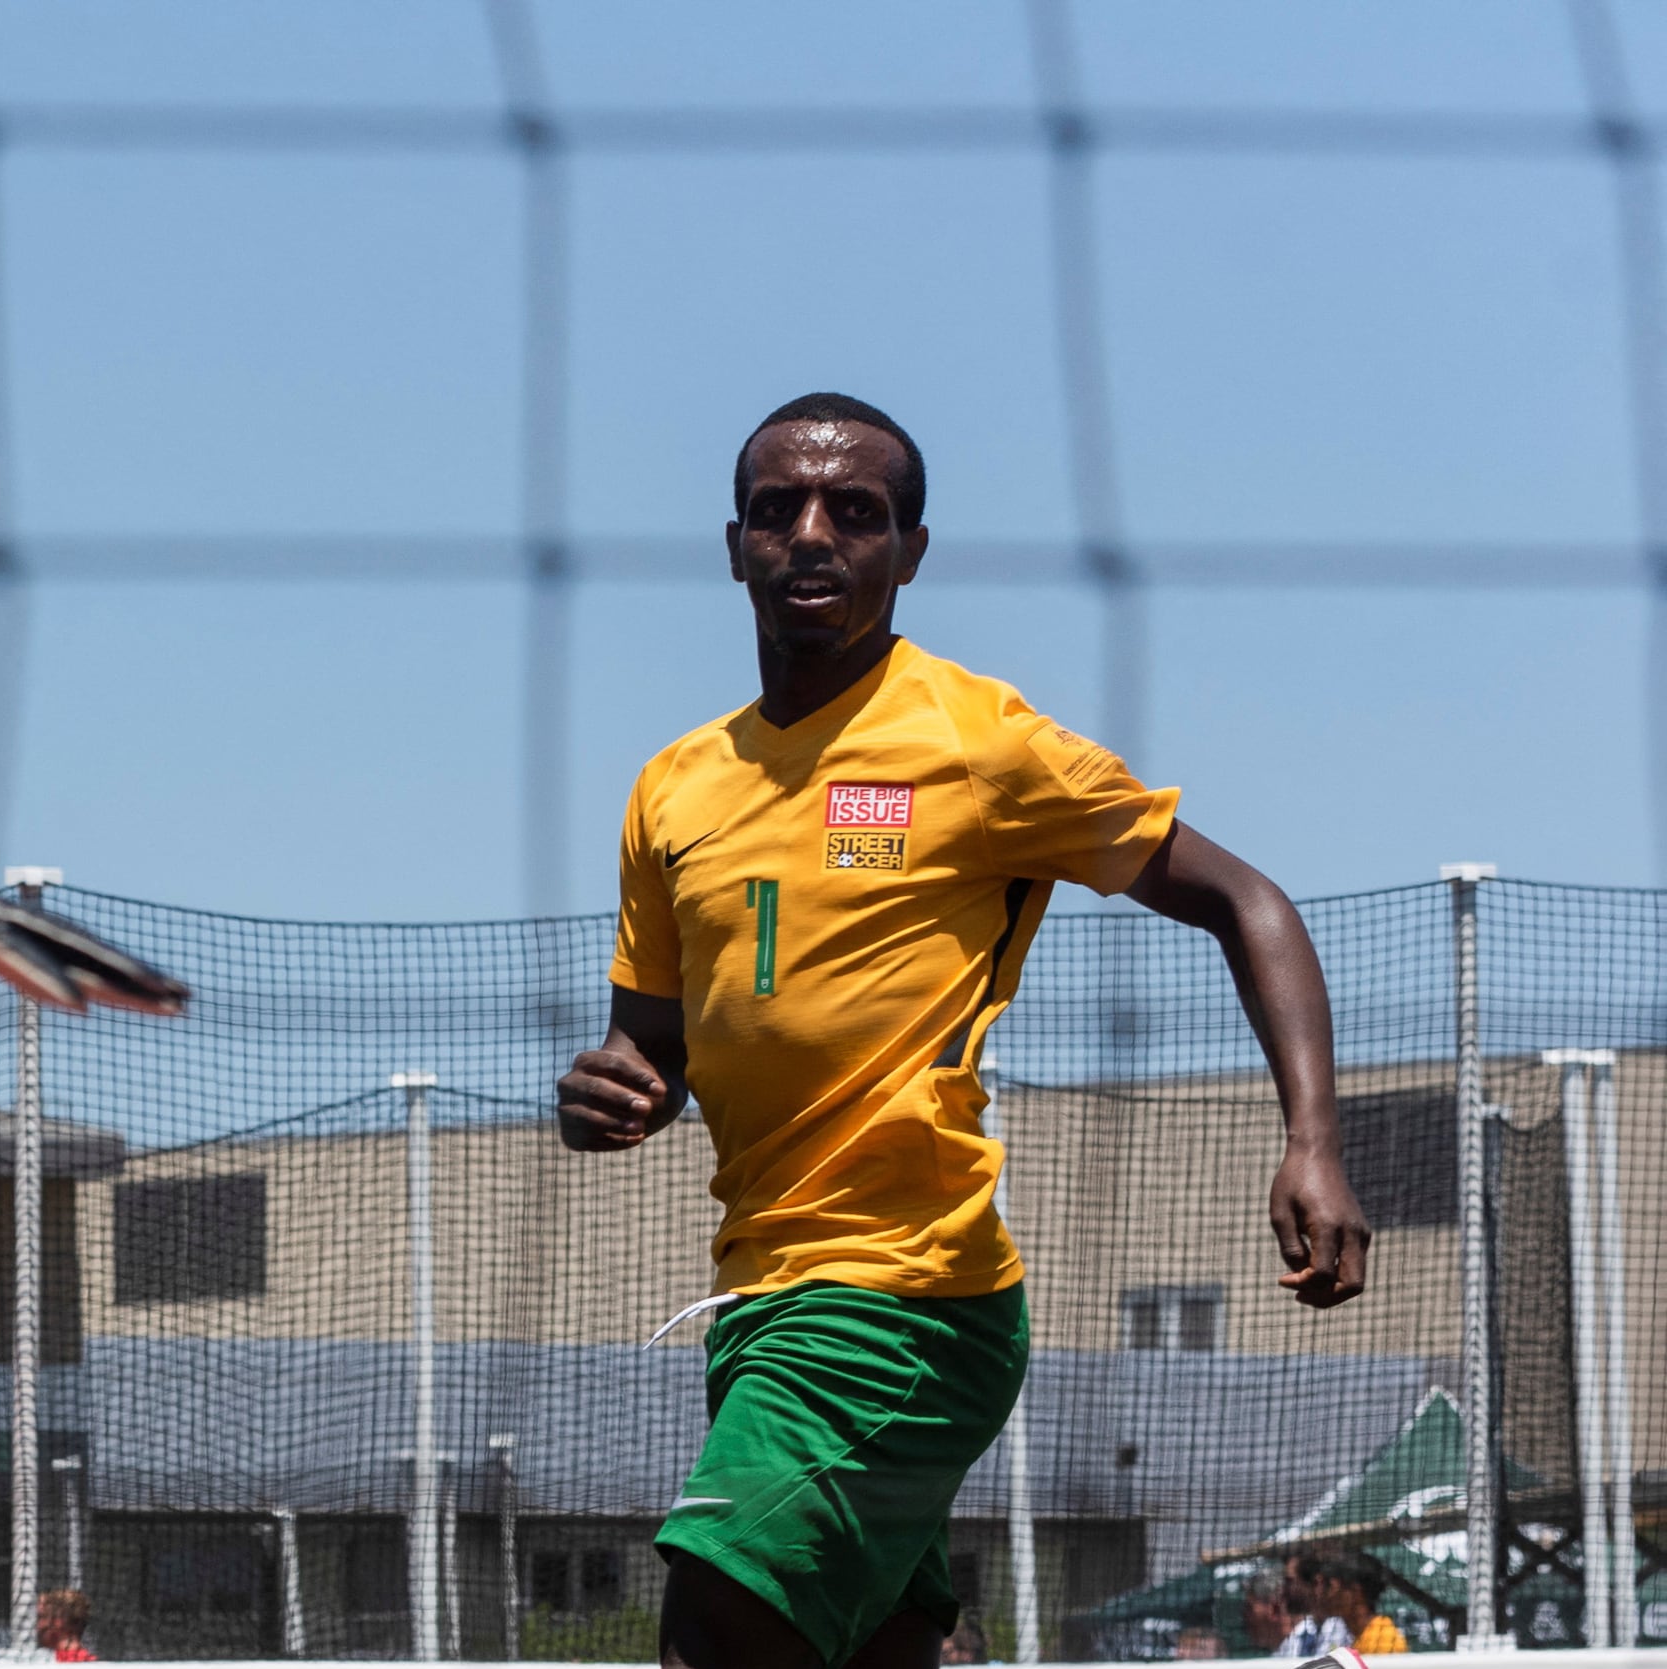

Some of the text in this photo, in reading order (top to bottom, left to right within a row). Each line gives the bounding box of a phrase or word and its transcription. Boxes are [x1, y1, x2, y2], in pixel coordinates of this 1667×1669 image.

[834, 788, 907, 801] THE BIG
[832, 801, 907, 822] ISSUE
[829, 833, 903, 853] STREET
[746, 879, 779, 995] 1
